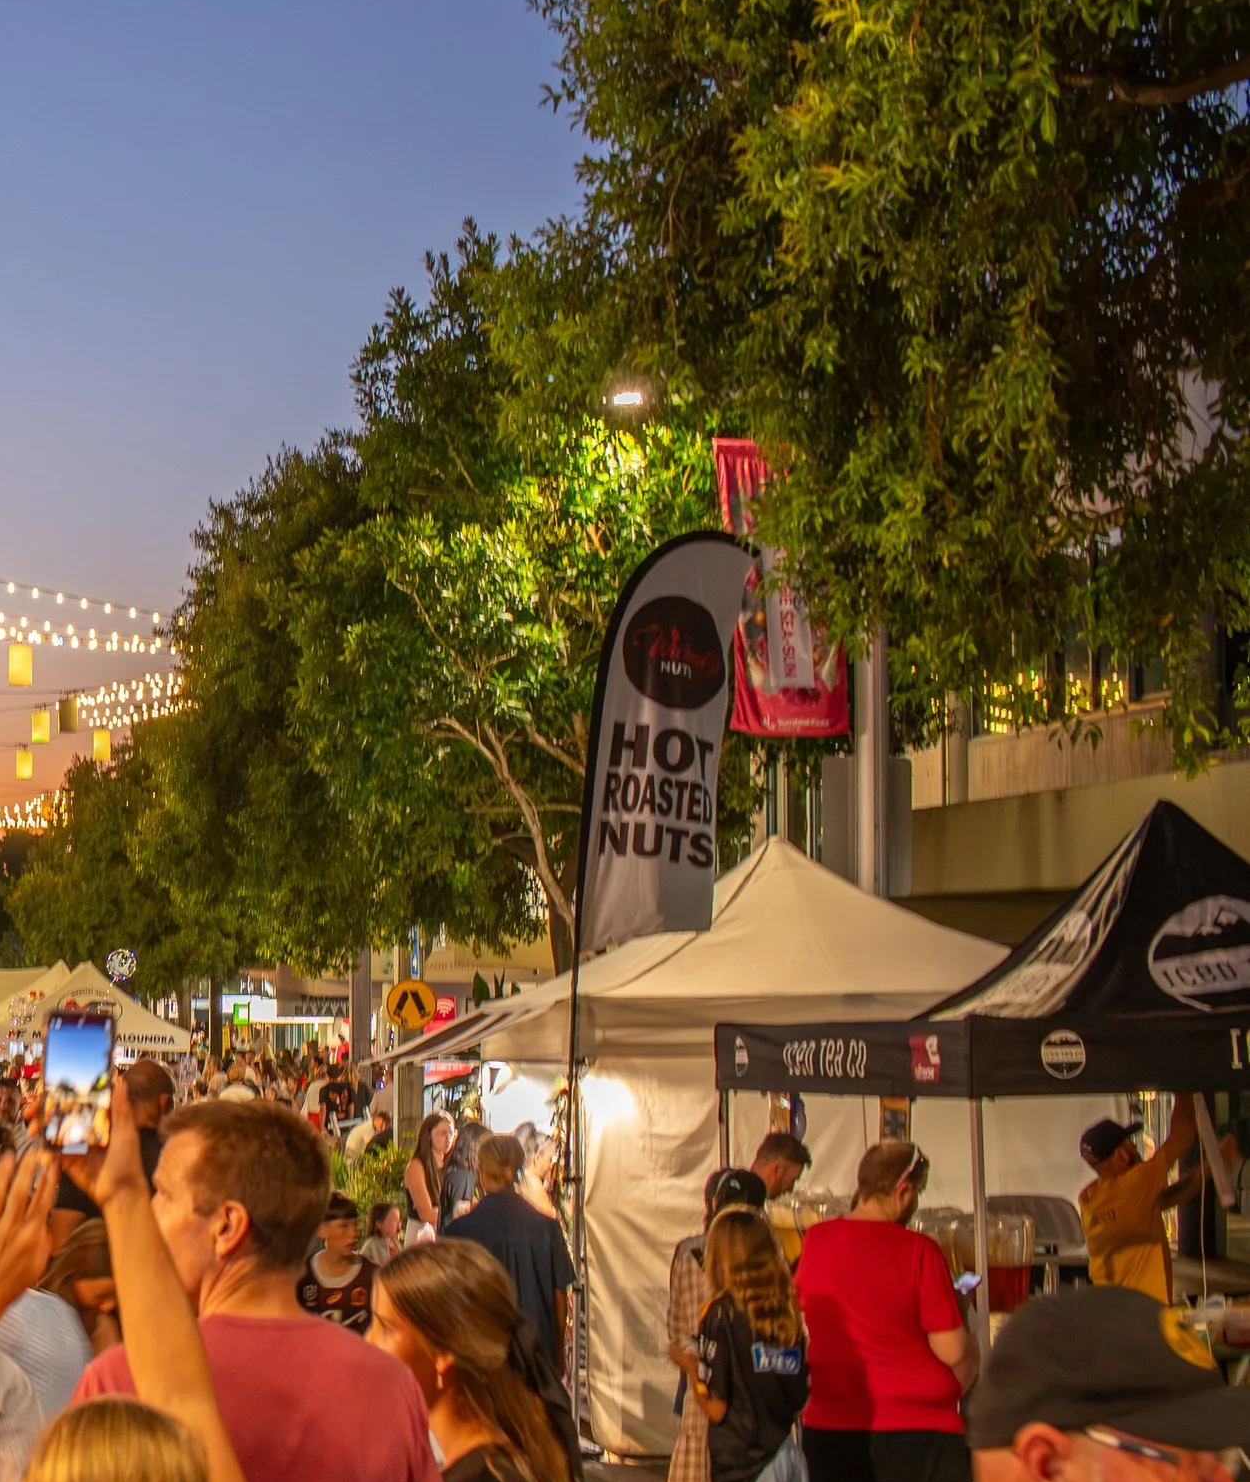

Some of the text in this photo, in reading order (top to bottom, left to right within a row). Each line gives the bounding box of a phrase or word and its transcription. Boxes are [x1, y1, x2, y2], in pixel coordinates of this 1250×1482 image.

[608, 722, 714, 781] HOT
[602, 770, 713, 825] ROASTED
[598, 820, 714, 869] NUTS
[116, 1033, 176, 1046] ALOUNDRA
